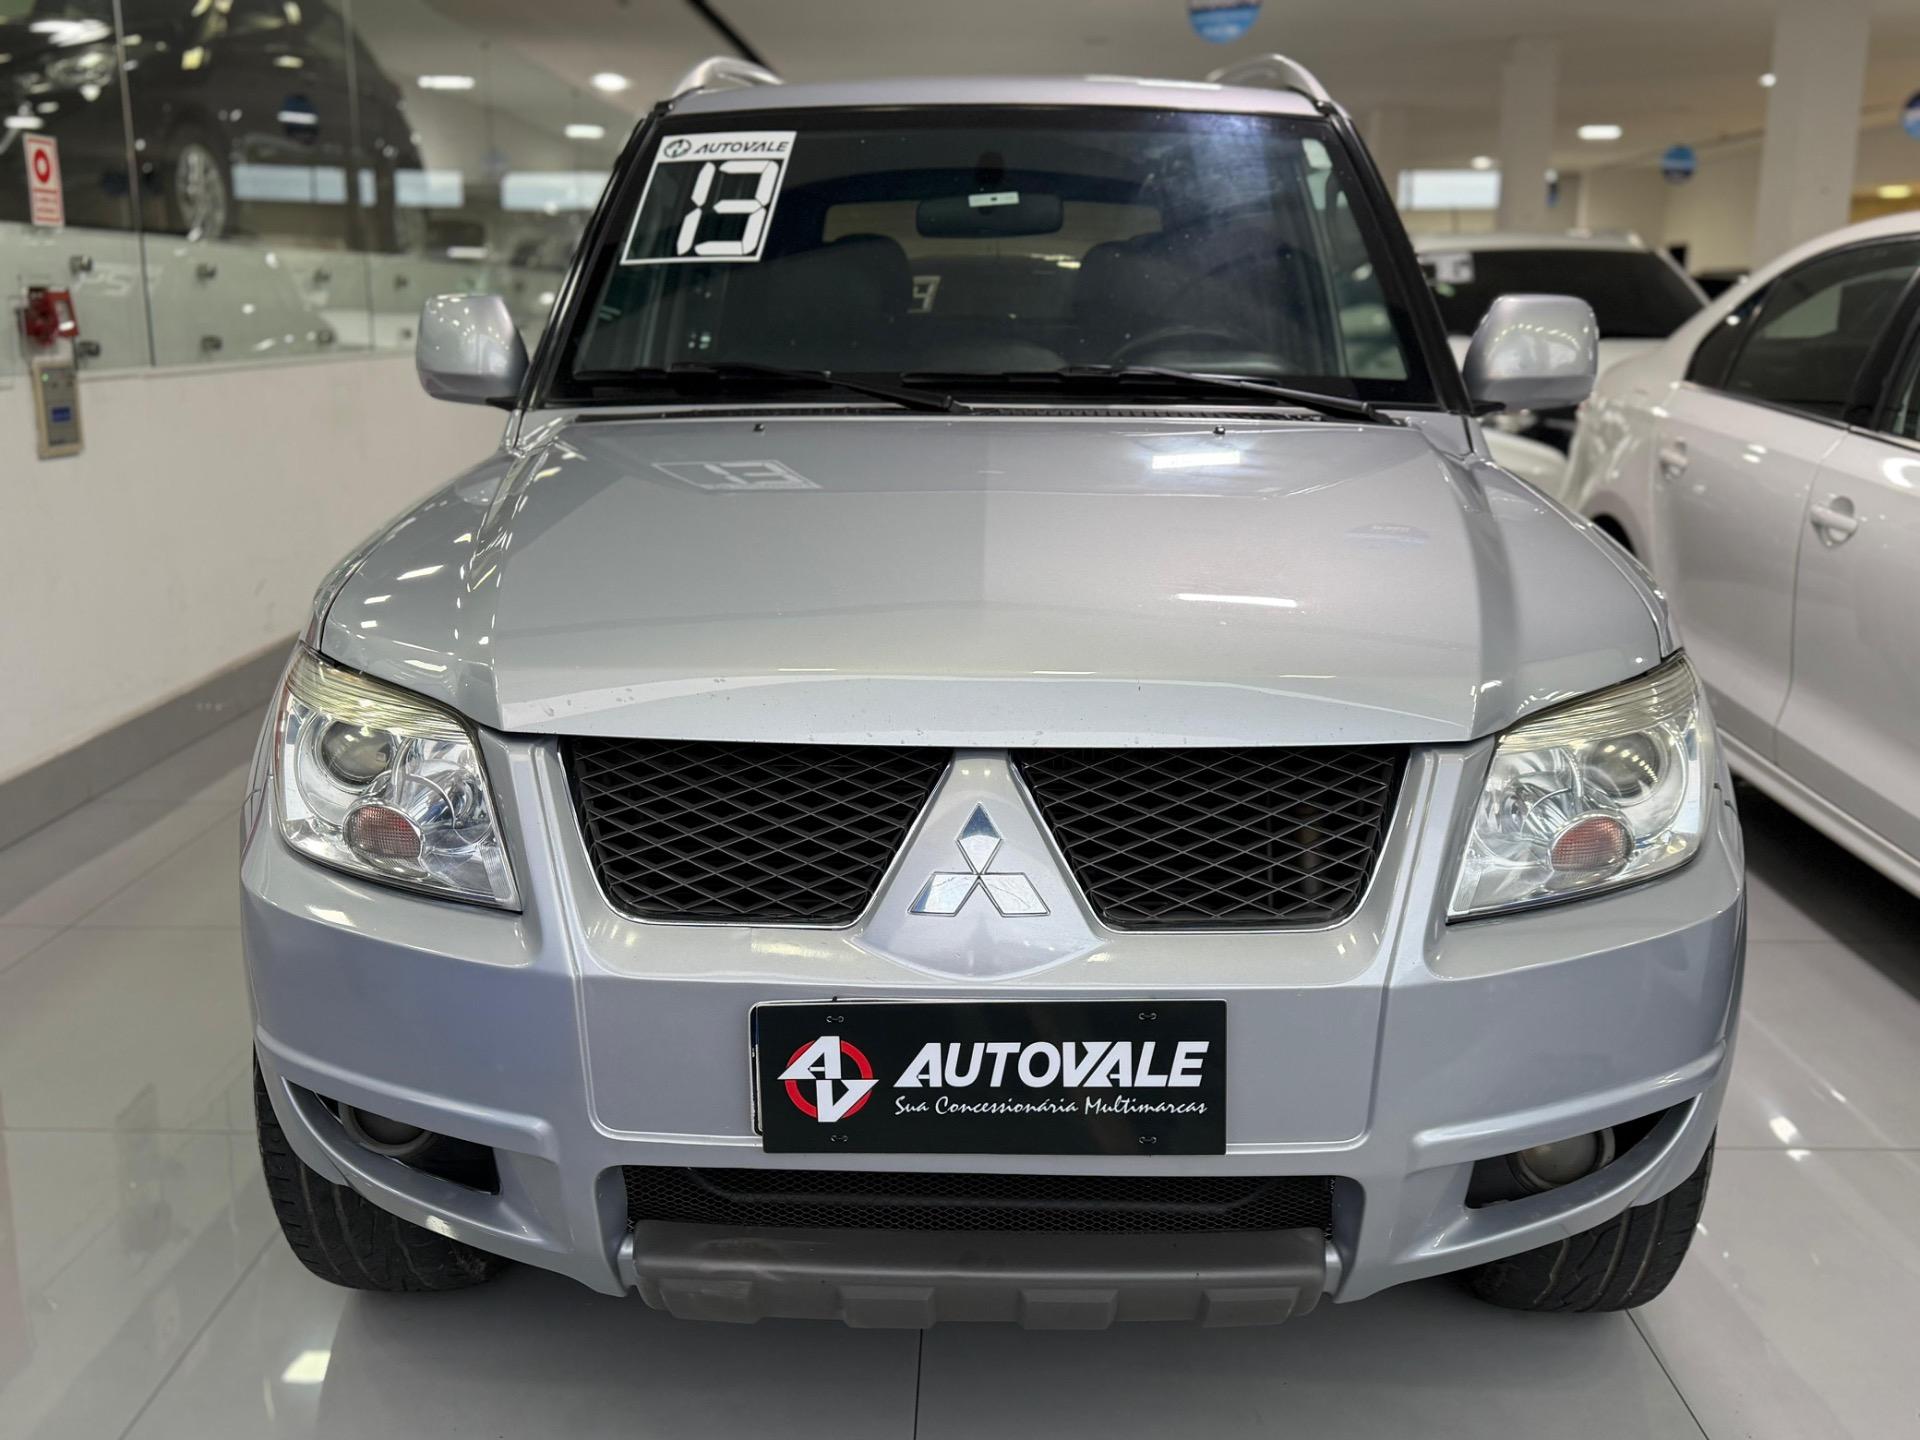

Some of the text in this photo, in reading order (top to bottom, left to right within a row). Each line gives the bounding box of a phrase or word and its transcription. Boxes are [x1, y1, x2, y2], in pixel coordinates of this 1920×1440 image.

[693, 141, 789, 155] AUTOVALE
[676, 160, 780, 256] 13
[893, 1041, 1210, 1088] AUTOVALE
[894, 1095, 1209, 1117] Sua Concessionária Multimarcas
